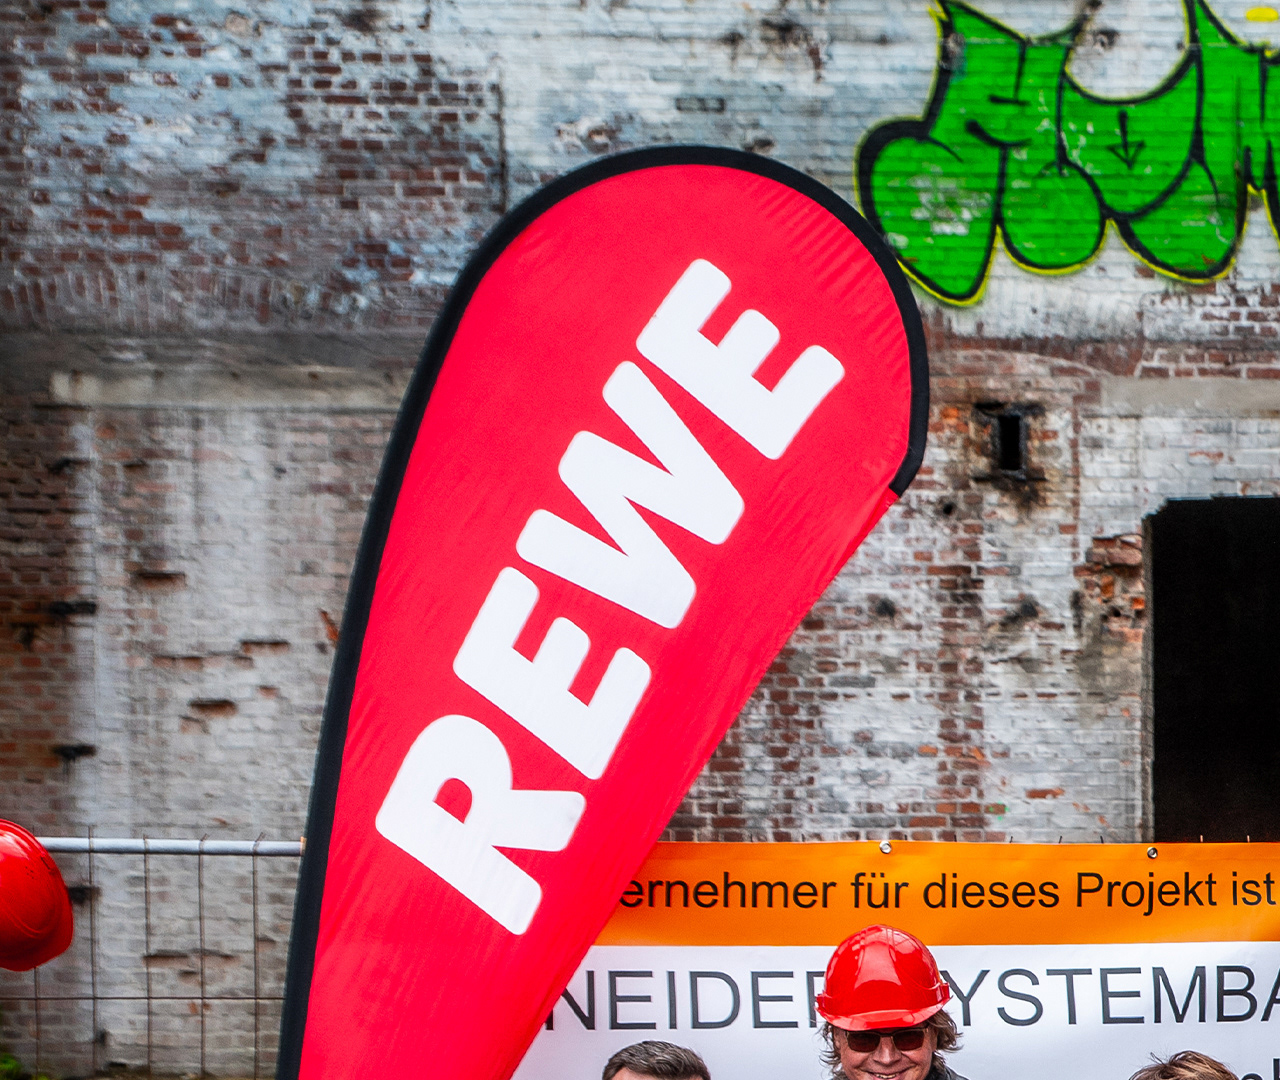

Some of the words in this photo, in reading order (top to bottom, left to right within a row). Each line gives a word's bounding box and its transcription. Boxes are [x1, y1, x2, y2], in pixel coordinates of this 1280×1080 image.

[375, 258, 845, 936] REWE
[619, 871, 837, 909] ernehmer
[850, 871, 909, 909] für
[923, 872, 1059, 909] dieses
[1077, 871, 1217, 917] Projekt
[1232, 871, 1276, 906] ist
